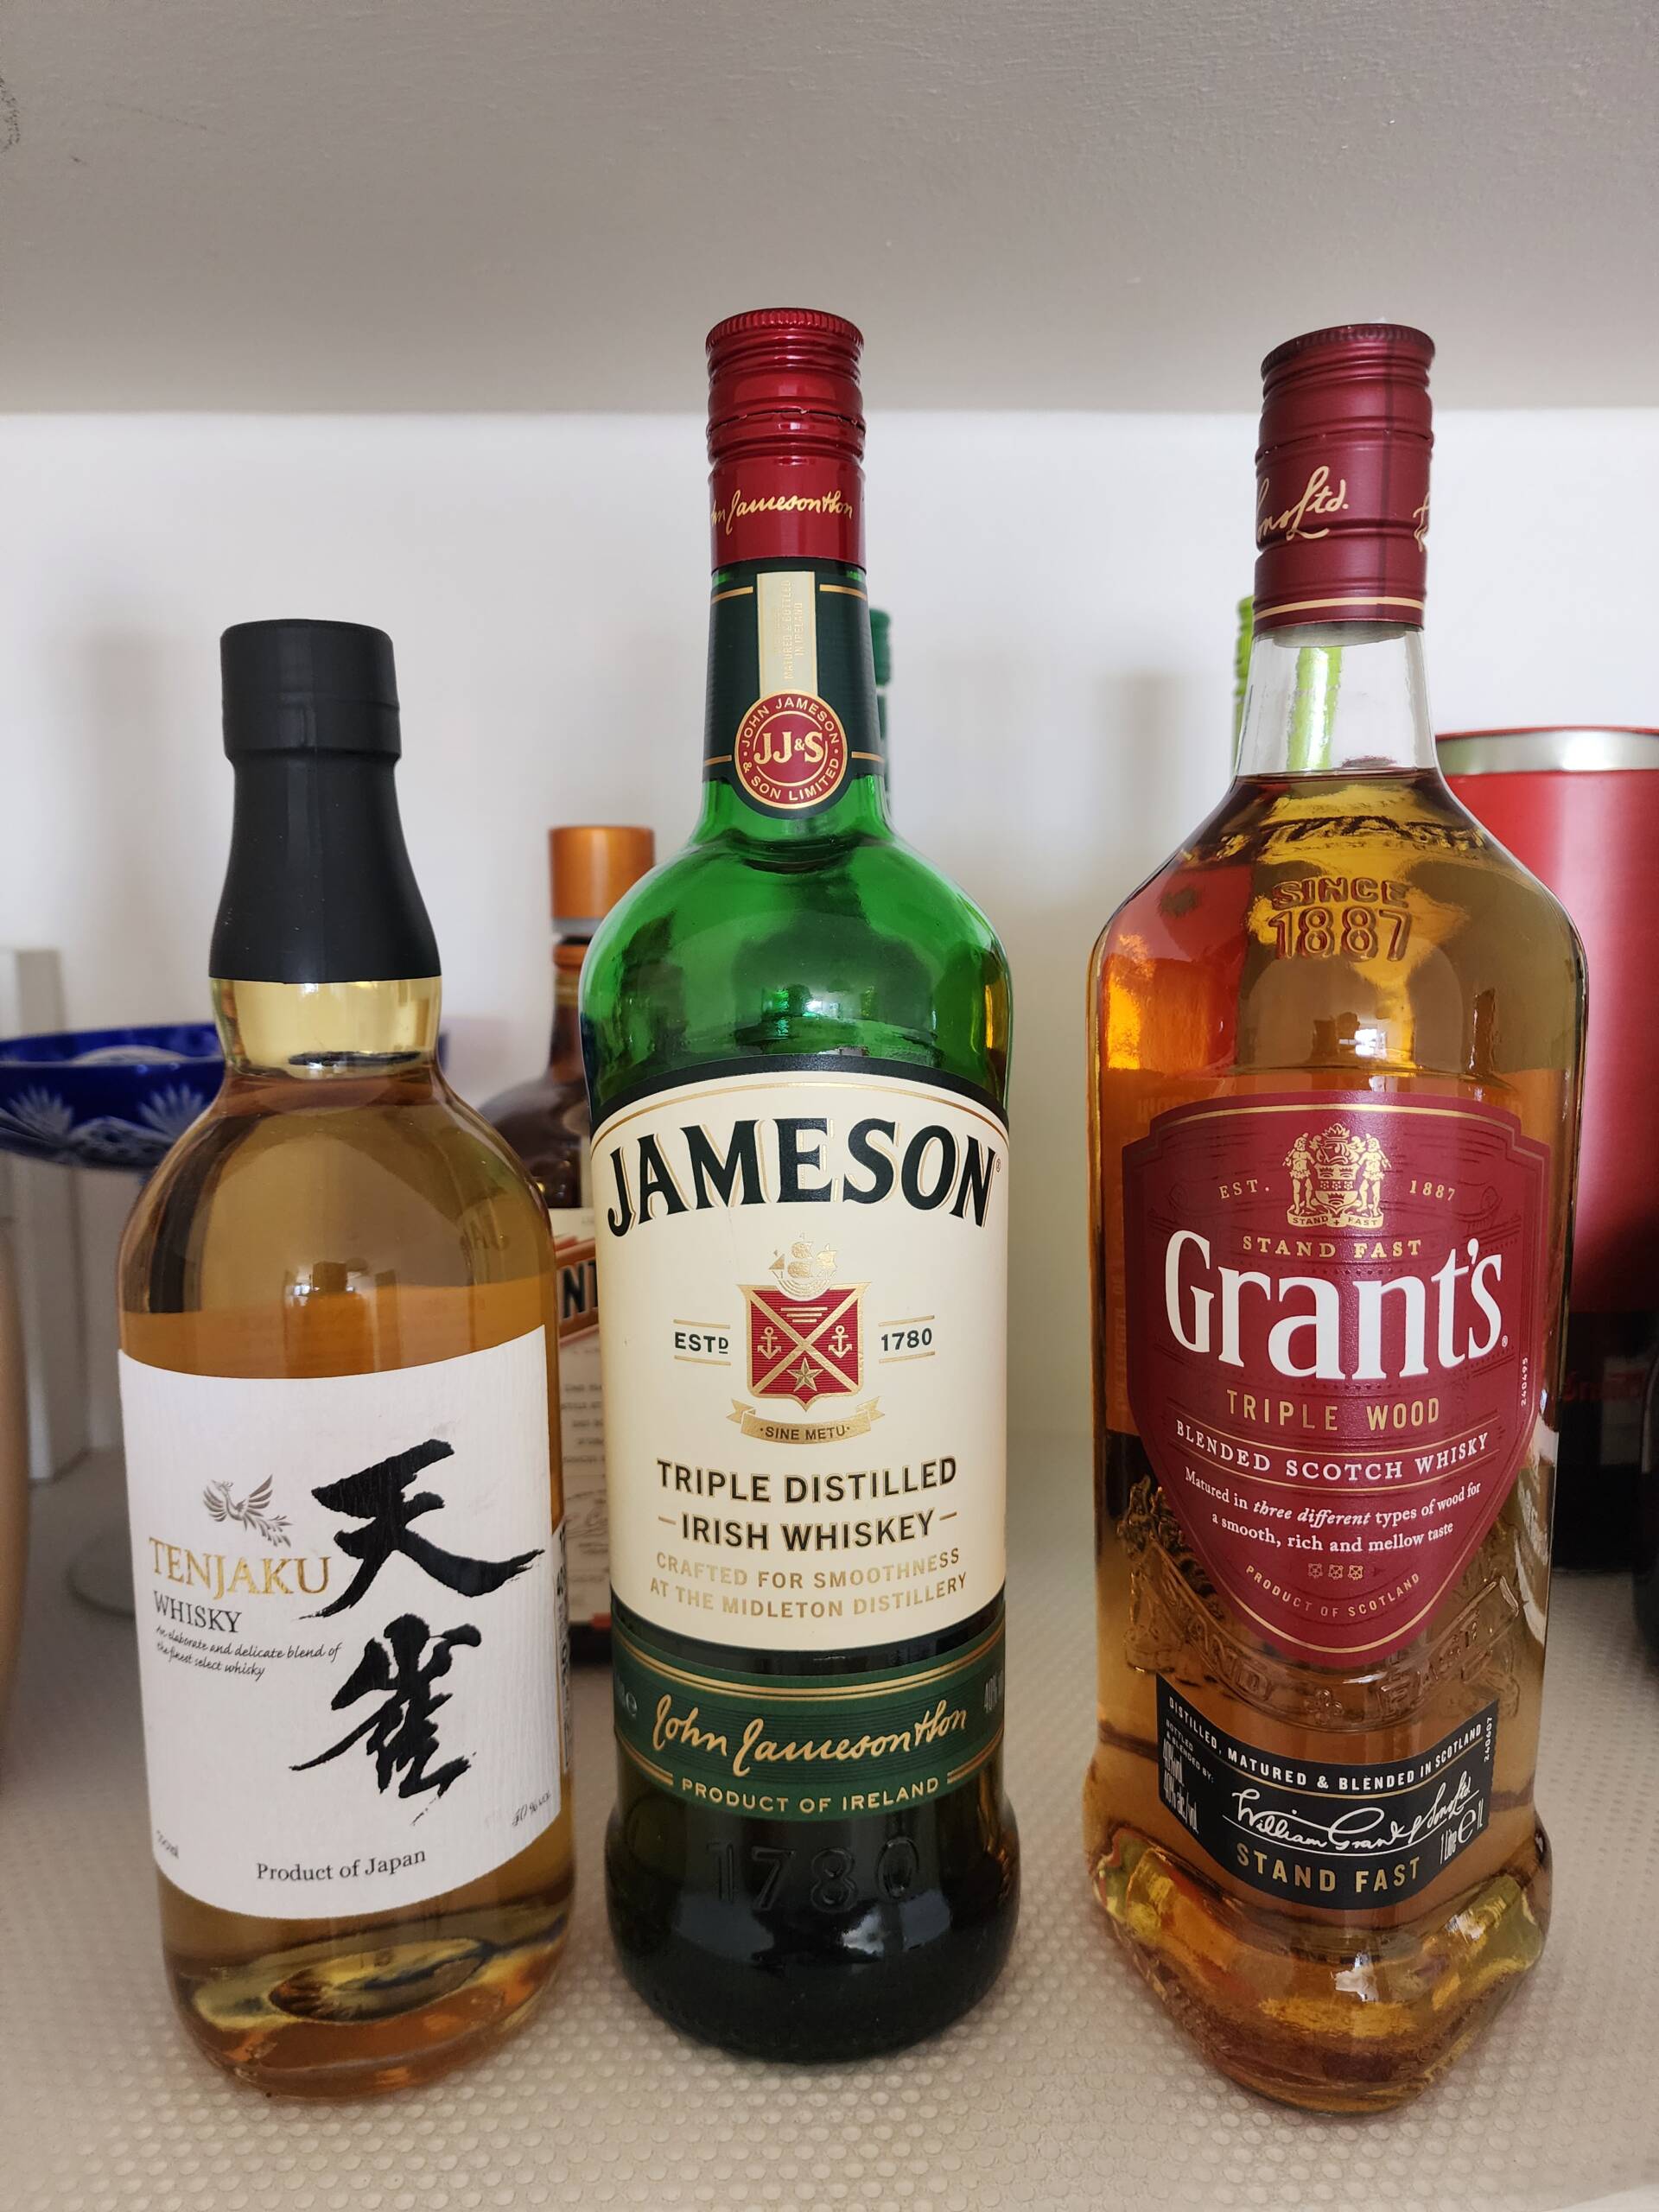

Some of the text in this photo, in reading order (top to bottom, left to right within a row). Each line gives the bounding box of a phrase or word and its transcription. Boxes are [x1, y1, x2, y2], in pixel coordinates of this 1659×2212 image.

[741, 696, 840, 747] JOHN JAMESON
[753, 731, 824, 765] JJ&S
[751, 776, 782, 800] SON
[788, 758, 840, 801] LIMITED
[1271, 877, 1409, 910] SINCE
[1268, 906, 1413, 962] 1887
[607, 1117, 996, 1237] JAMESON
[1218, 1179, 1457, 1201] EST. 1887
[1292, 1216, 1378, 1226] STAND FAST
[1243, 1236, 1422, 1259] STAND FAST
[1165, 1230, 1503, 1382] Grant's
[880, 1327, 932, 1352] 1780
[1226, 1389, 1440, 1431] TRIPLE WOOD
[765, 1424, 846, 1440] SINE METU
[1176, 1419, 1490, 1482] BLENDED SCOTCH WHISKY
[657, 1456, 957, 1504] TRIPLE DISTILLED
[1185, 1466, 1481, 1529] Matured in three different types of wood for
[681, 1508, 937, 1552] IRISH WHISKEY
[1211, 1513, 1453, 1553] a smooth, rich and mellow taste
[149, 1537, 332, 1599] TENJAKU
[657, 1547, 959, 1589] CRAFTED FOR SMOOTHNESS
[153, 1590, 242, 1633] WHISKY
[650, 1571, 967, 1618] AT THE MIDLETON DISTILLERY
[1246, 1565, 1420, 1618] PRODUCT OF SCOTLAND
[194, 1657, 222, 1672] select
[225, 1658, 265, 1682] whisky
[210, 1643, 232, 1656] and
[235, 1644, 284, 1659] delicate
[287, 1641, 325, 1659] blend
[328, 1642, 343, 1663] of
[653, 1694, 727, 1751] John
[1166, 1719, 1193, 1751] BOTTLED
[1484, 1717, 1492, 1763] 240607
[1172, 1735, 1200, 1770] BLENDED
[1228, 1747, 1306, 1786] MATURED
[1317, 1776, 1329, 1789] &
[1339, 1770, 1414, 1791] BLENDED
[1421, 1762, 1431, 1778] IN
[1435, 1724, 1482, 1768] SCOTLAND
[682, 1777, 939, 1814] PRODUCT OF IRELAND
[257, 1850, 427, 1881] Product of Japan
[707, 1836, 919, 1913] 1780
[1236, 1842, 1420, 1893] STAND FAST
